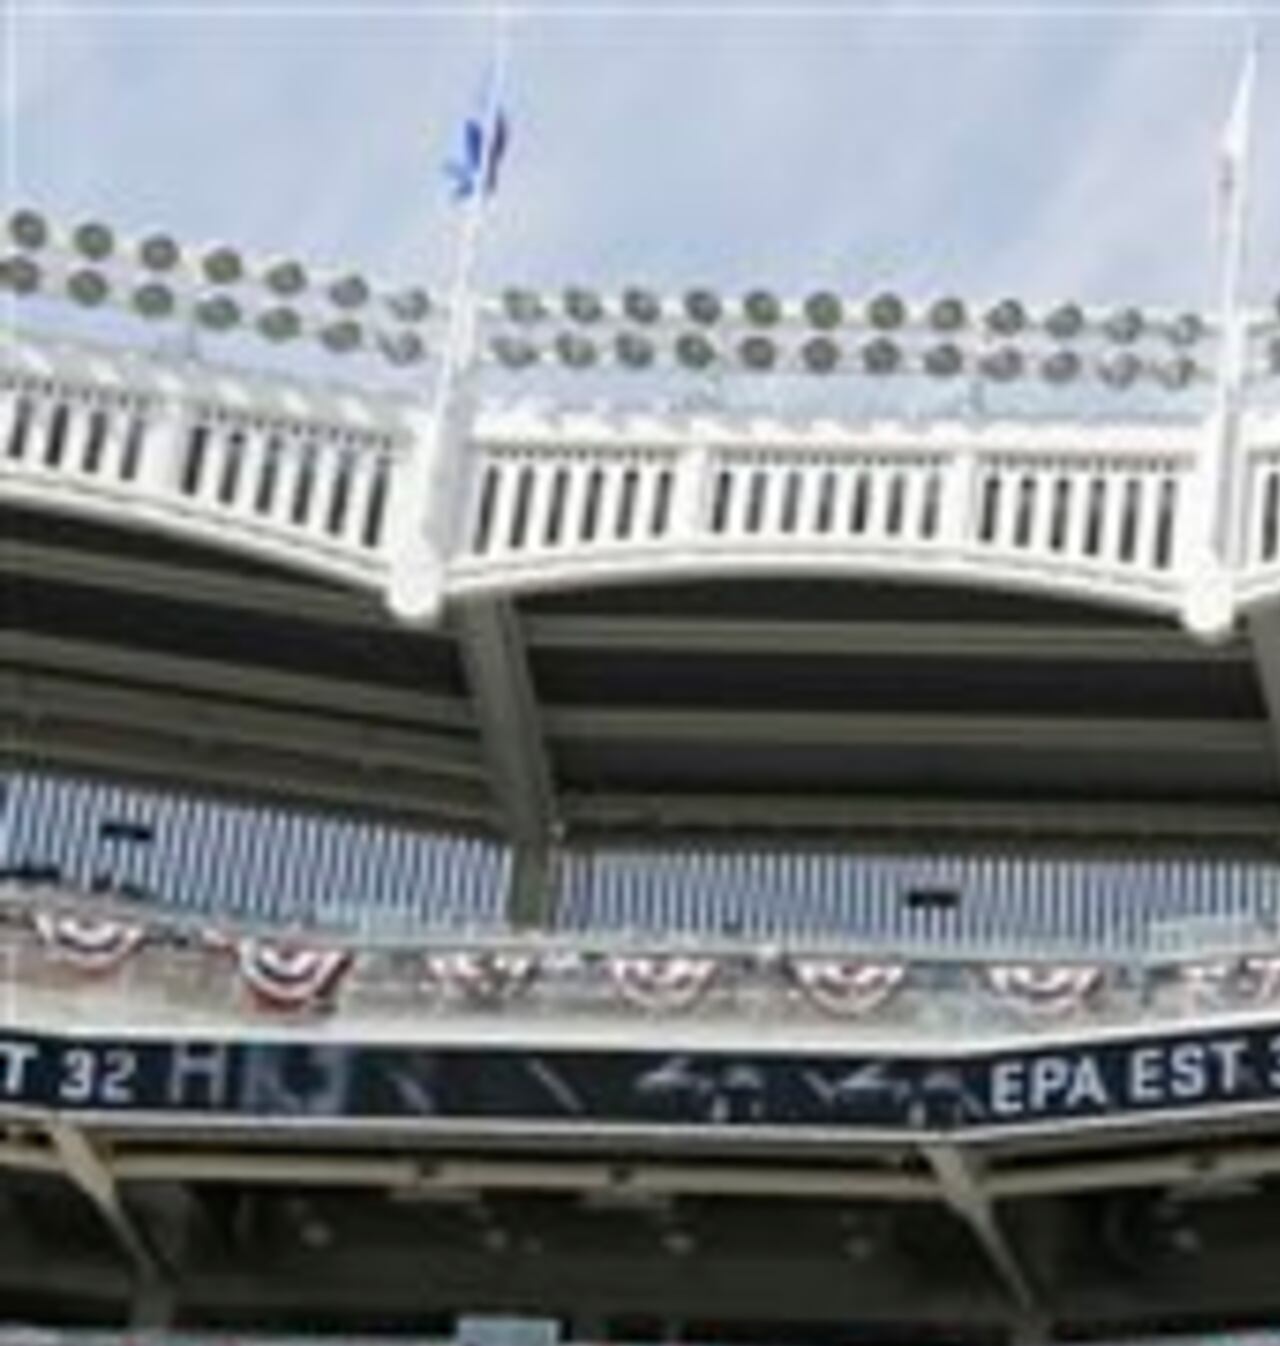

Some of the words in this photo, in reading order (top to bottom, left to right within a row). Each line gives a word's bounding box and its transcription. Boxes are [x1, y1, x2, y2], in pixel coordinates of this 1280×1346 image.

[60, 1049, 136, 1100] 32
[990, 1056, 1108, 1112] EPA
[1130, 1040, 1248, 1099] EST
